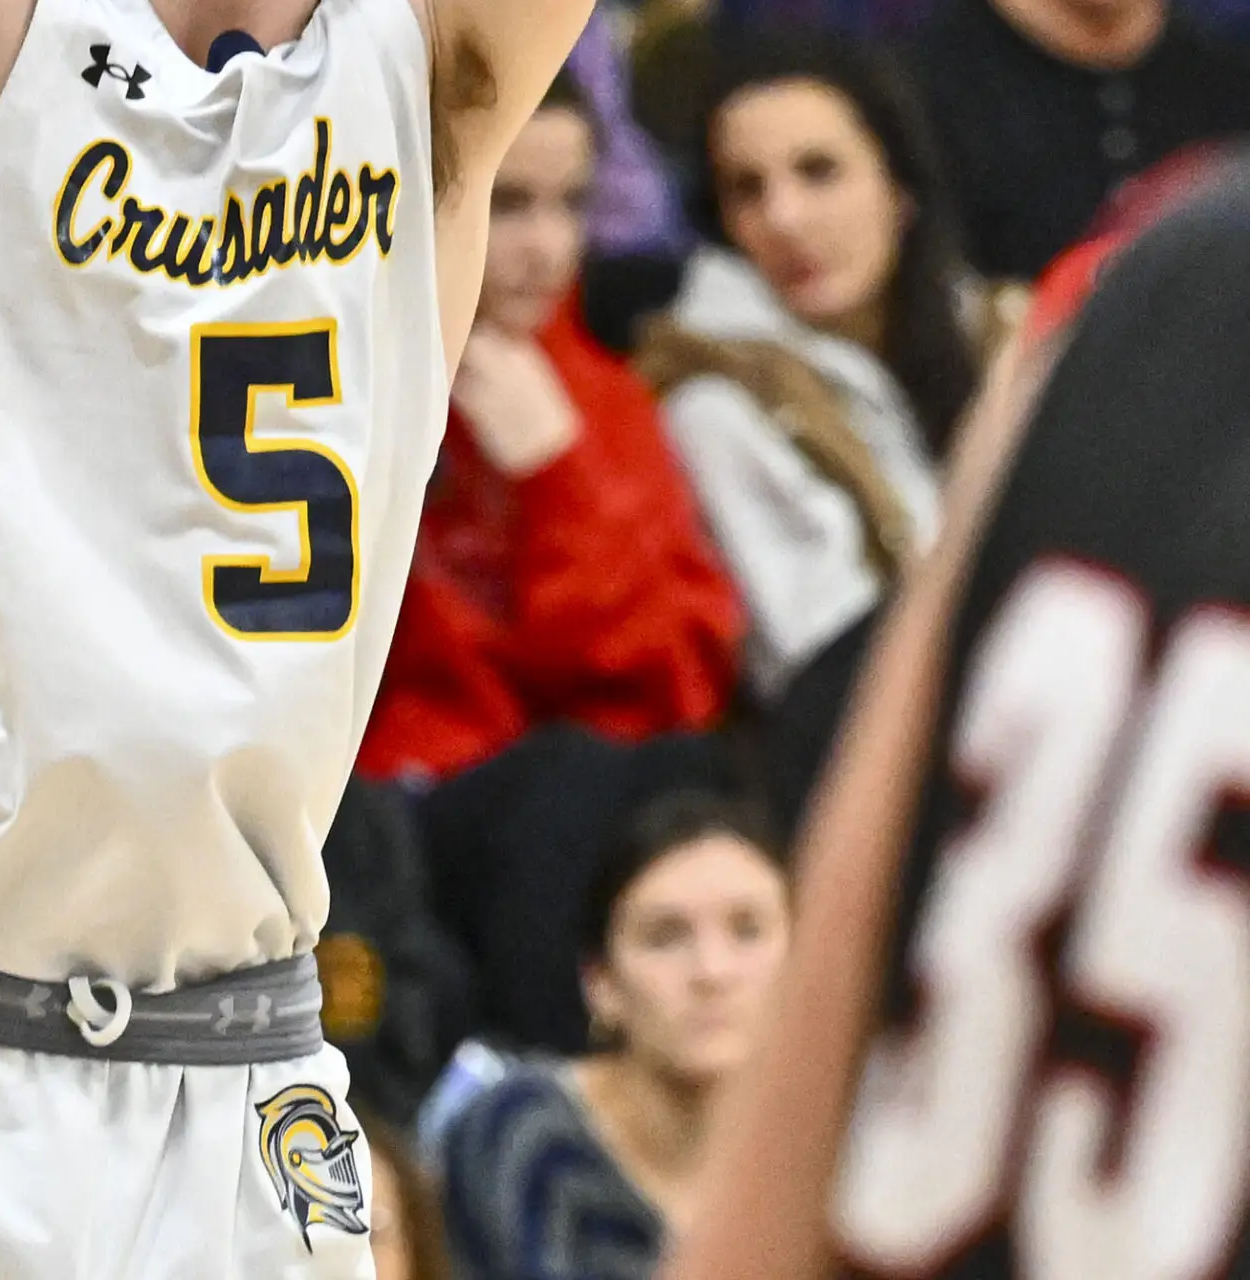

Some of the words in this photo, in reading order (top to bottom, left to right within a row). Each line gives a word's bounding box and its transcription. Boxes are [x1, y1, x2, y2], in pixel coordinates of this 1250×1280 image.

[55, 116, 401, 287] Crusader
[190, 317, 359, 642] 5
[830, 556, 1250, 1280] 35
